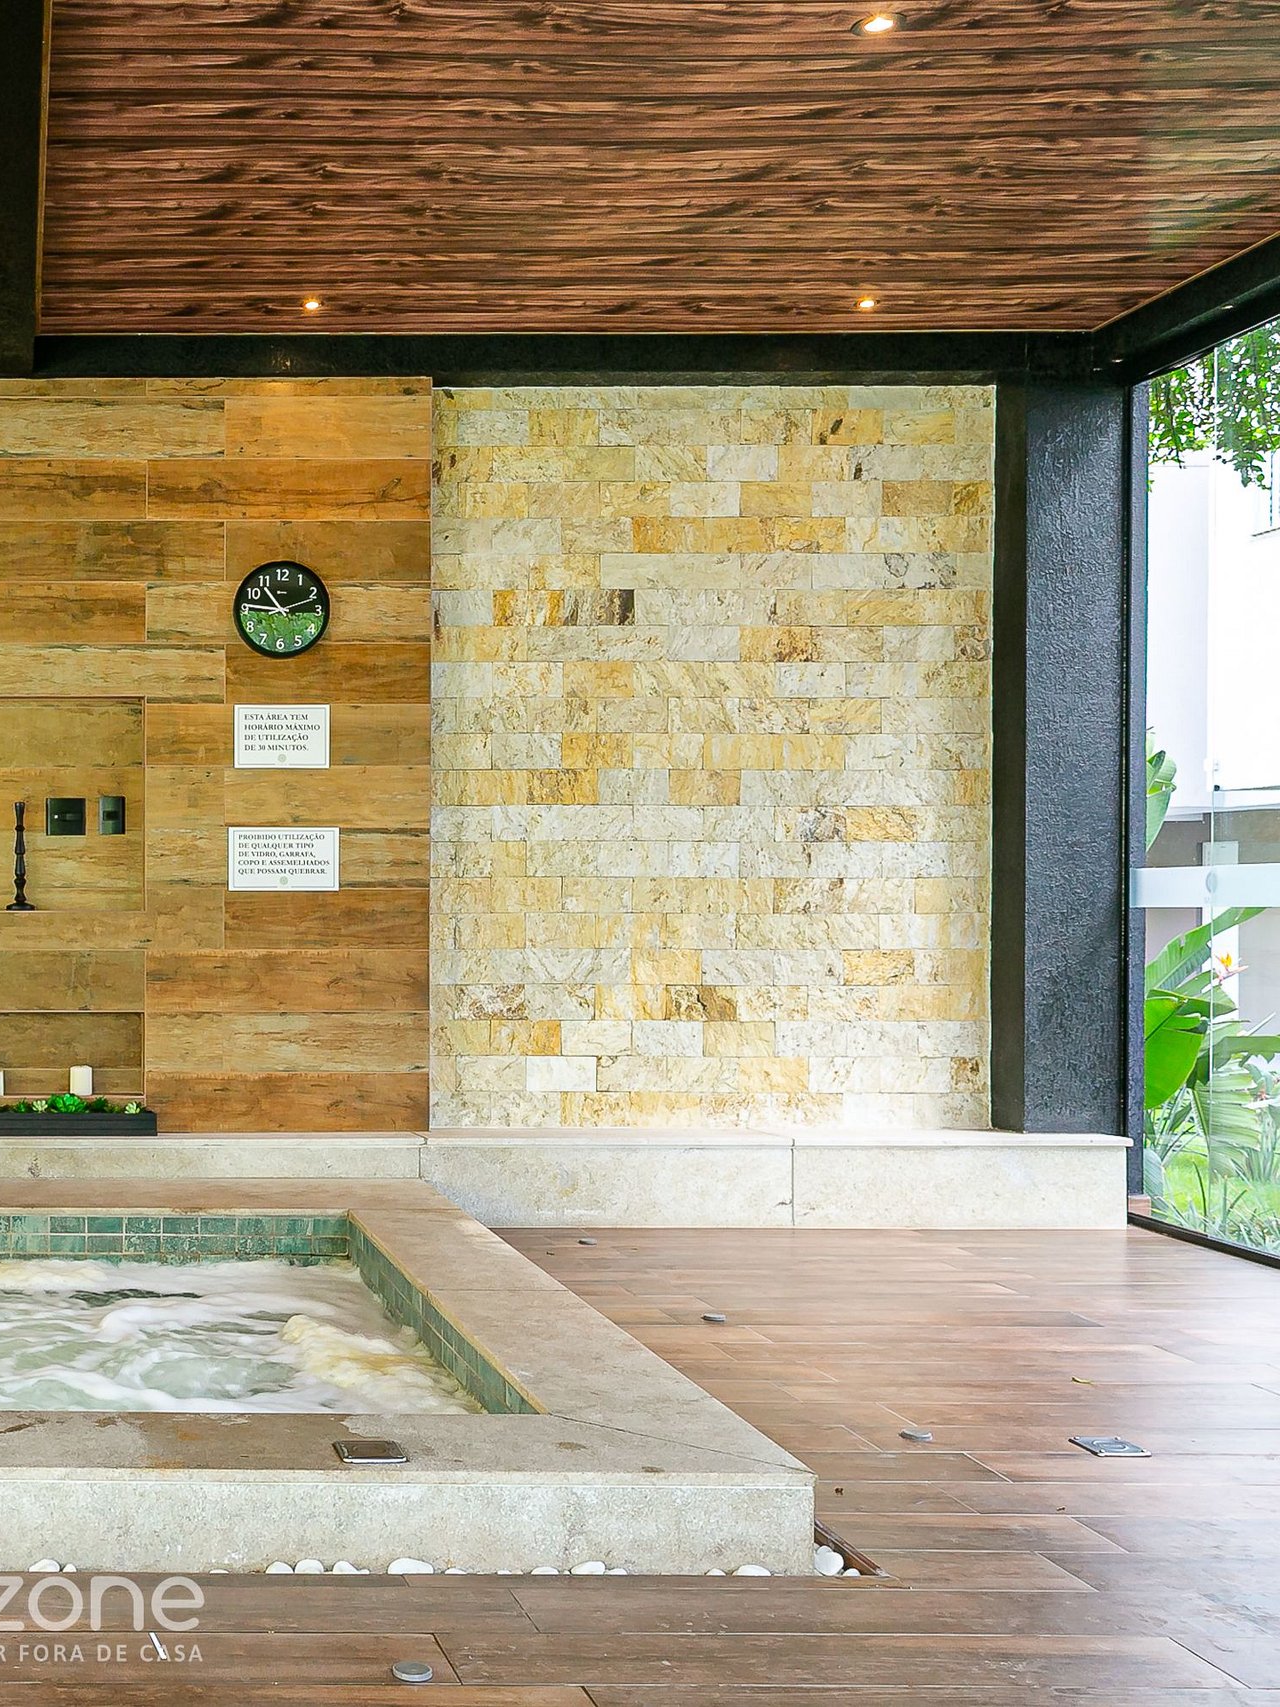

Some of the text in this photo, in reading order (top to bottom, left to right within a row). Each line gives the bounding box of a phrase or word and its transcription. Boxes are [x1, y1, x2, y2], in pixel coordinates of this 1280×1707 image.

[258, 575, 270, 587] 11
[276, 569, 290, 581] 12
[297, 574, 303, 586] 1
[247, 588, 261, 600] 10
[309, 587, 317, 599] 2
[241, 603, 249, 614] 9
[314, 605, 322, 617] 3
[246, 621, 254, 633] 8
[306, 624, 315, 634] 4
[260, 634, 267, 645] 7
[276, 638, 285, 650] 6
[294, 635, 302, 646] 5
[258, 733, 309, 742] UTILIZAÇÃO
